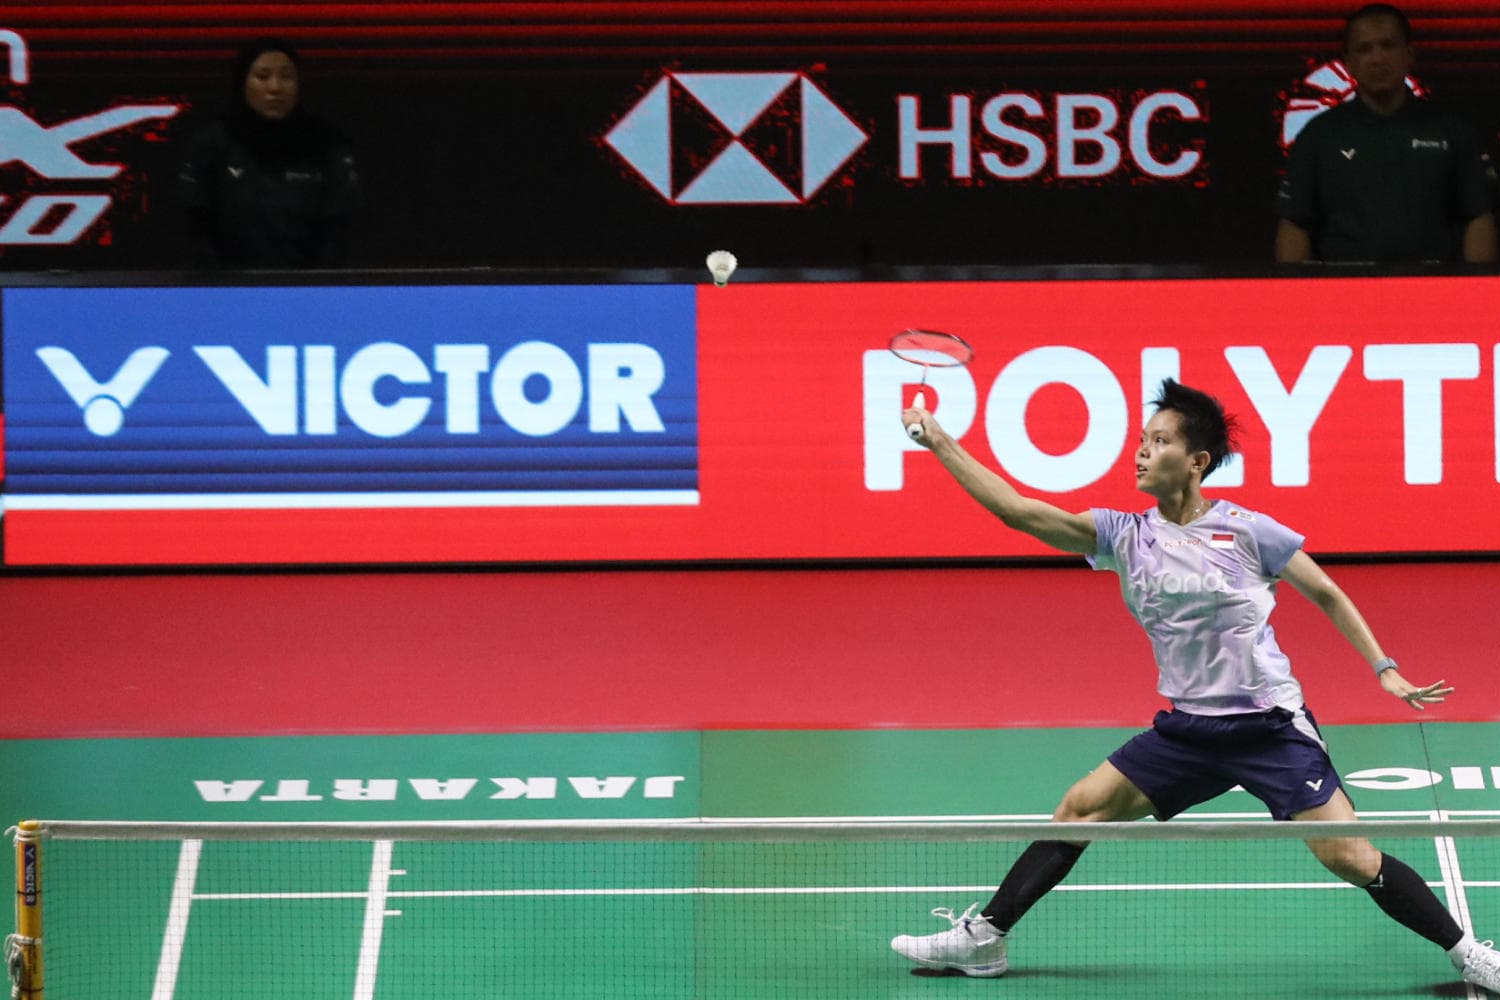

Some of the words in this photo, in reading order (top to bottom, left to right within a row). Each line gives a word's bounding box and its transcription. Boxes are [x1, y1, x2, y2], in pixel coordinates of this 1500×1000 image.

[899, 92, 1199, 178] HSBC
[194, 341, 665, 437] VICTOR
[194, 775, 686, 802] JAKARTA
